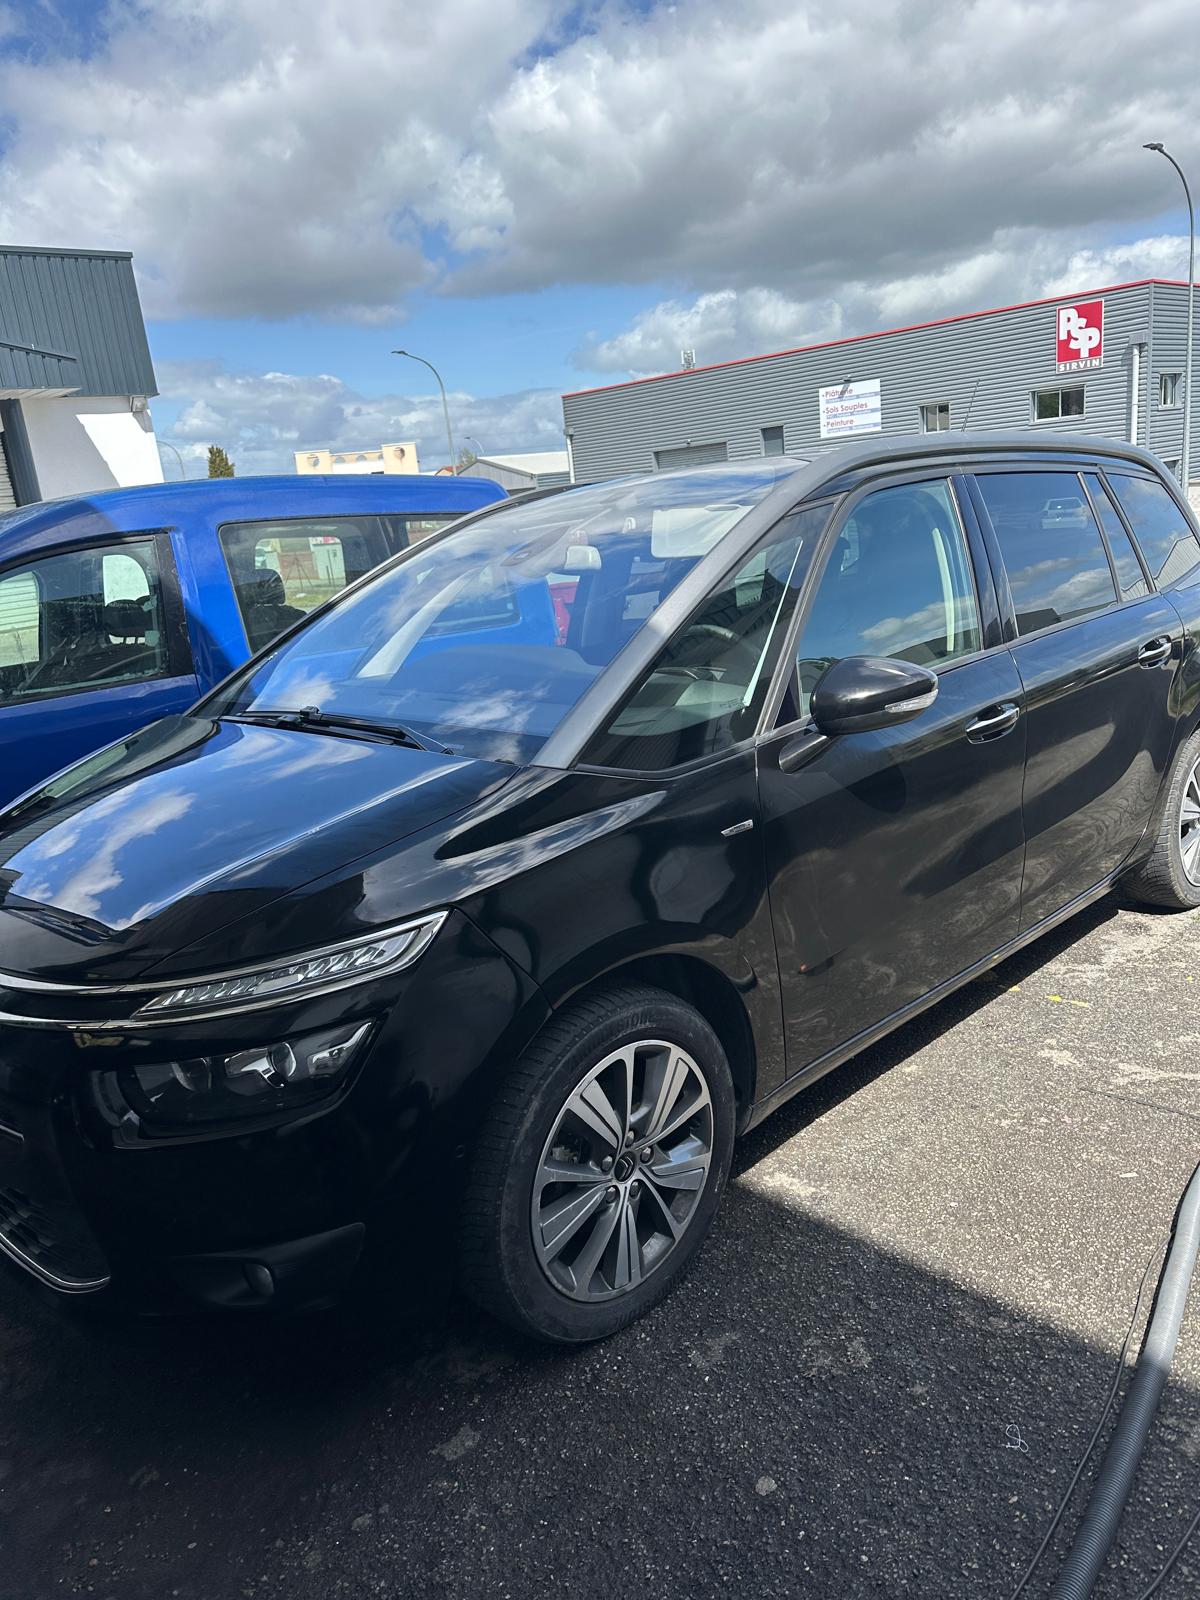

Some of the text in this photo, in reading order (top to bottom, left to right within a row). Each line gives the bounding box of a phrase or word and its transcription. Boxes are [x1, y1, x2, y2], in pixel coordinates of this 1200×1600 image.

[1059, 358, 1100, 371] SIRVIN
[825, 388, 853, 398] Plâtrie
[825, 406, 839, 414] Sols
[840, 402, 868, 413] Souples
[826, 419, 854, 428] Peinture
